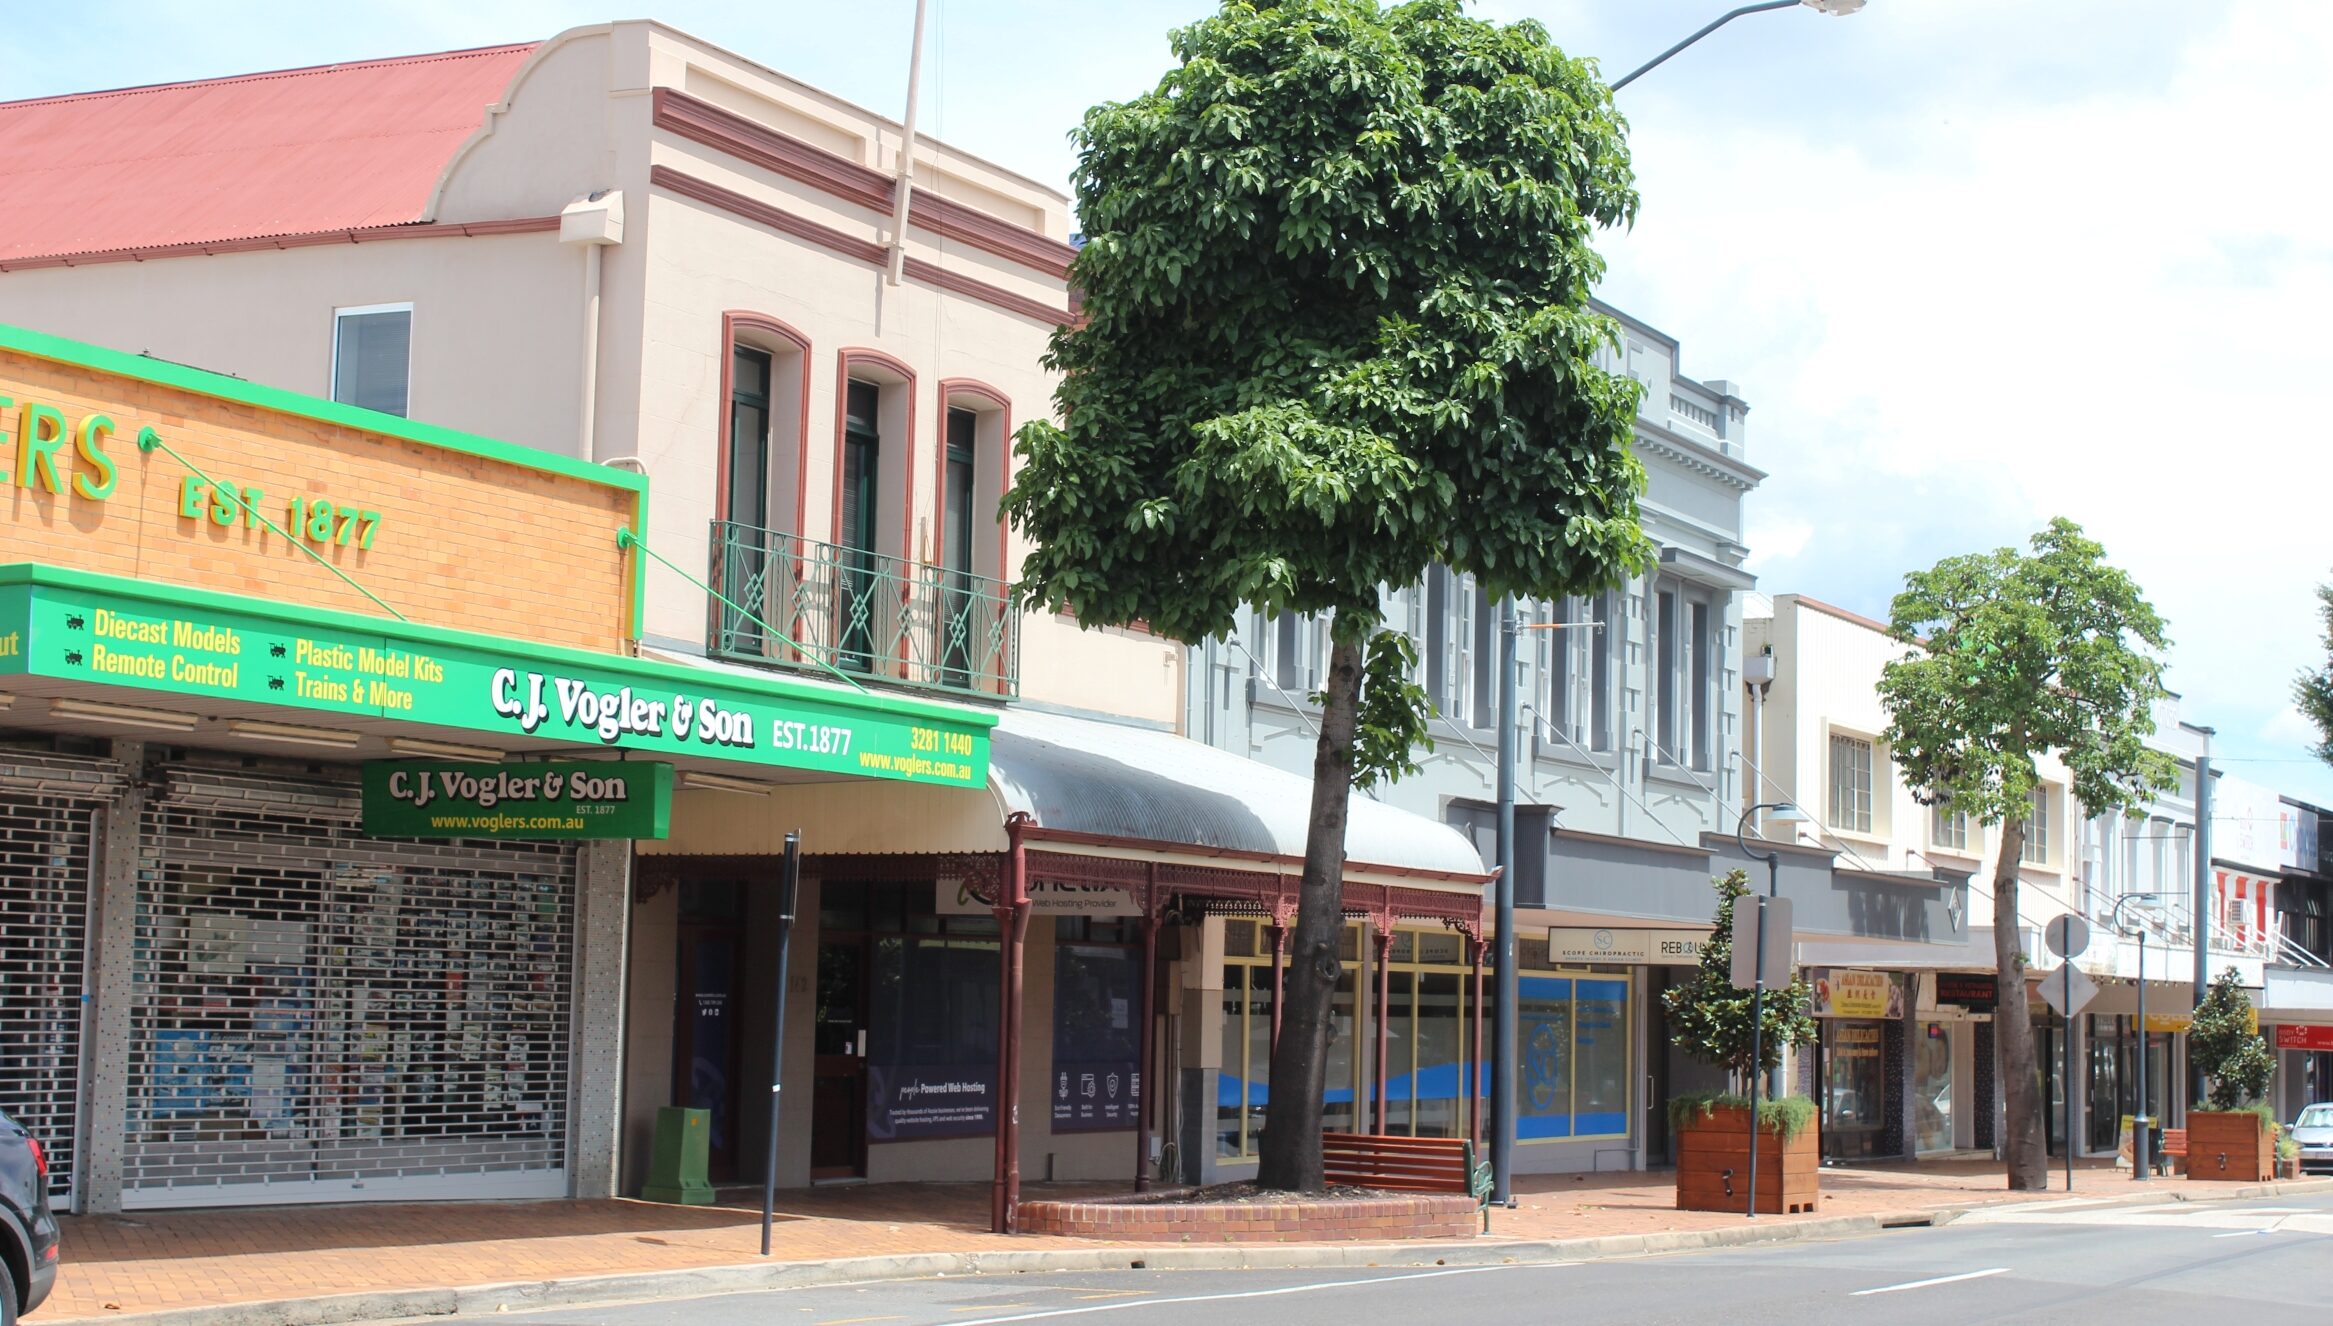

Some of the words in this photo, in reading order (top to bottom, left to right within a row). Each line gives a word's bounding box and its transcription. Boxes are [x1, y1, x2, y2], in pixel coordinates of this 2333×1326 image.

[179, 475, 276, 535] EST.
[288, 496, 382, 551] 1877
[94, 608, 168, 646] Diecast
[173, 620, 241, 656] Models
[92, 643, 166, 680] Remote
[171, 654, 238, 689] Control
[295, 638, 354, 671] Plastic
[358, 647, 410, 679] Model
[413, 655, 444, 684] Kits
[295, 671, 347, 703] Trains
[352, 678, 365, 704] &
[369, 682, 413, 711] More
[554, 677, 667, 744] Vogler
[671, 693, 695, 741] &
[698, 698, 755, 749] Son
[911, 726, 940, 753] 3281
[944, 733, 973, 757] 1440
[859, 750, 972, 781] www.voglers.com.au
[440, 771, 541, 807] Vogler
[543, 772, 564, 799] &
[570, 771, 628, 801] Son
[431, 812, 584, 832] www.voglers.com.au
[576, 804, 593, 815] EST.
[595, 804, 616, 815] 1877
[1032, 899, 1051, 909] Web
[1052, 899, 1083, 911] Hosting
[1084, 899, 1117, 909] Provider
[2279, 1036, 2307, 1045] SWITCH
[921, 1083, 947, 1094] Powered
[948, 1082, 961, 1093] Web
[962, 1082, 986, 1095] Hosting
